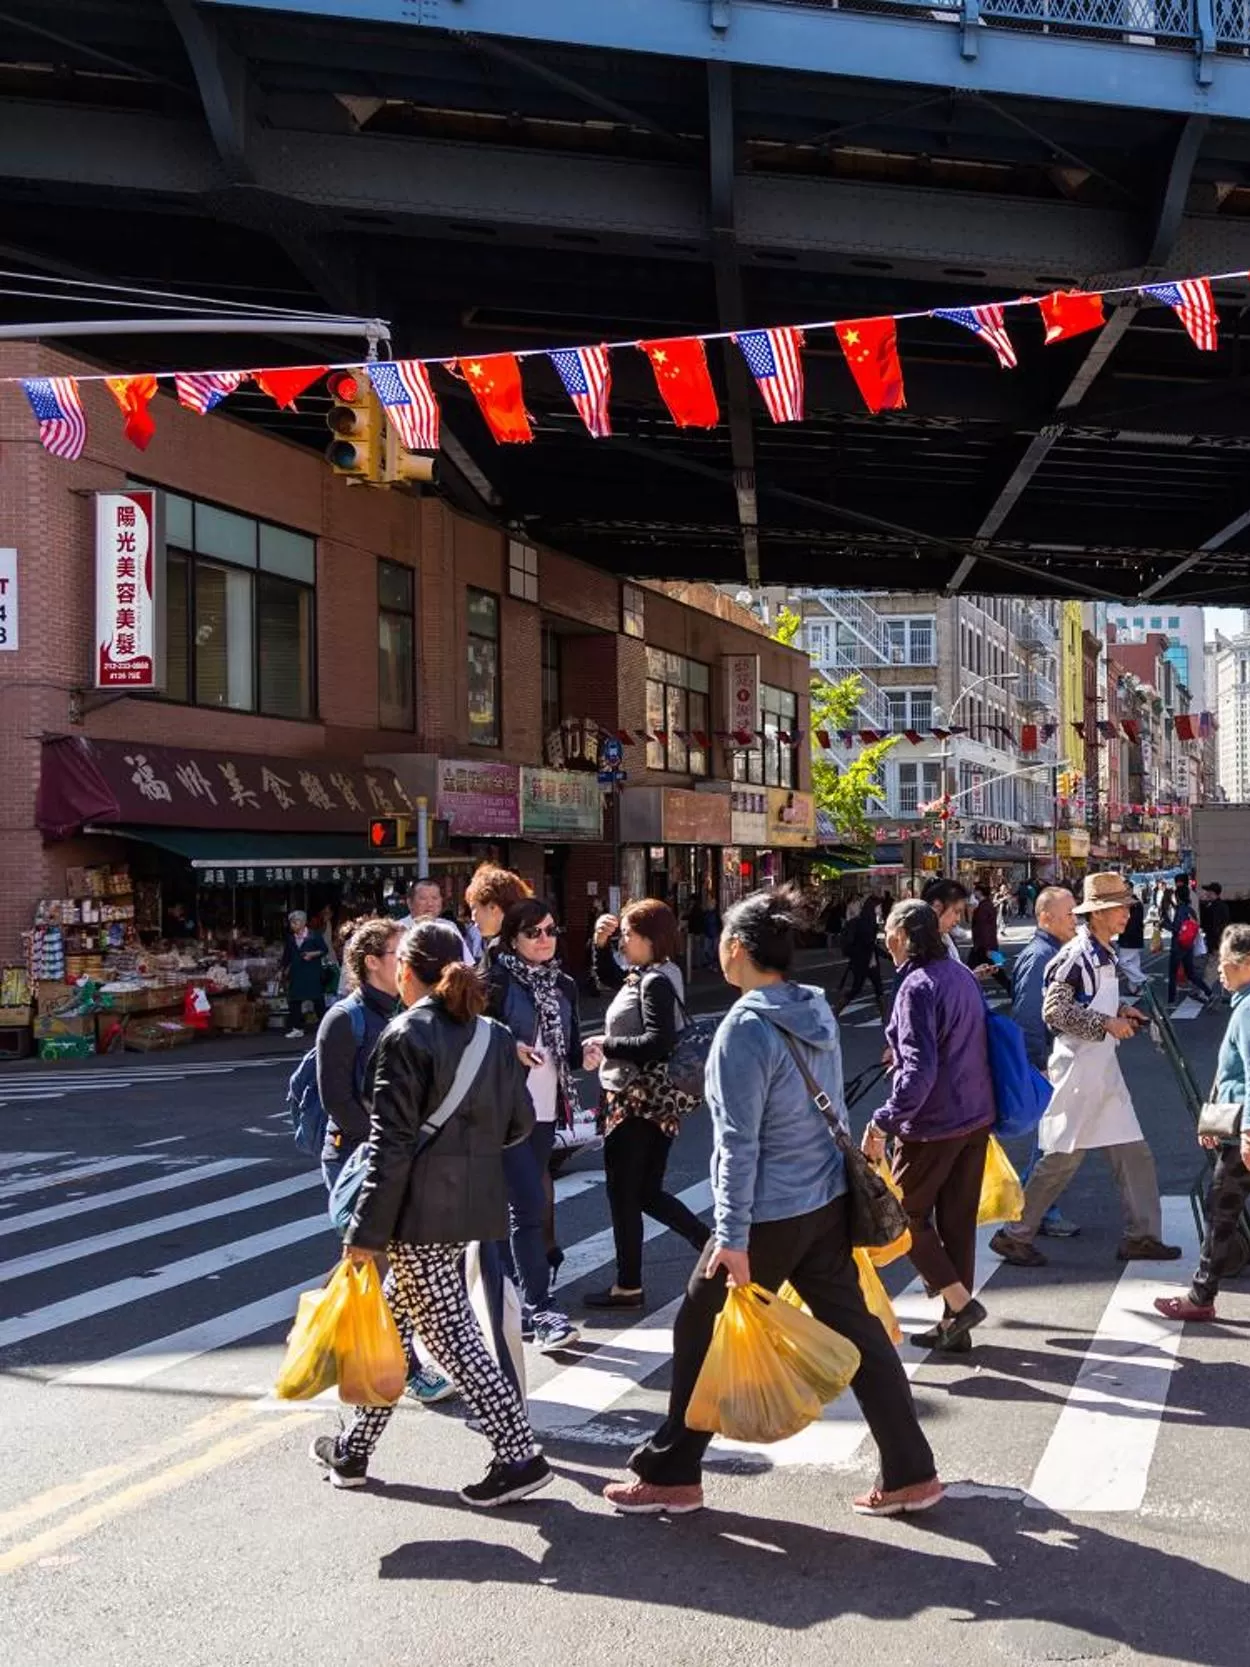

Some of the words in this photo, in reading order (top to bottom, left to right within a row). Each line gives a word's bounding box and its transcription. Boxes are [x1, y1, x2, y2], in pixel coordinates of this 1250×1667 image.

[116, 505, 136, 655] 陽光美容美髮
